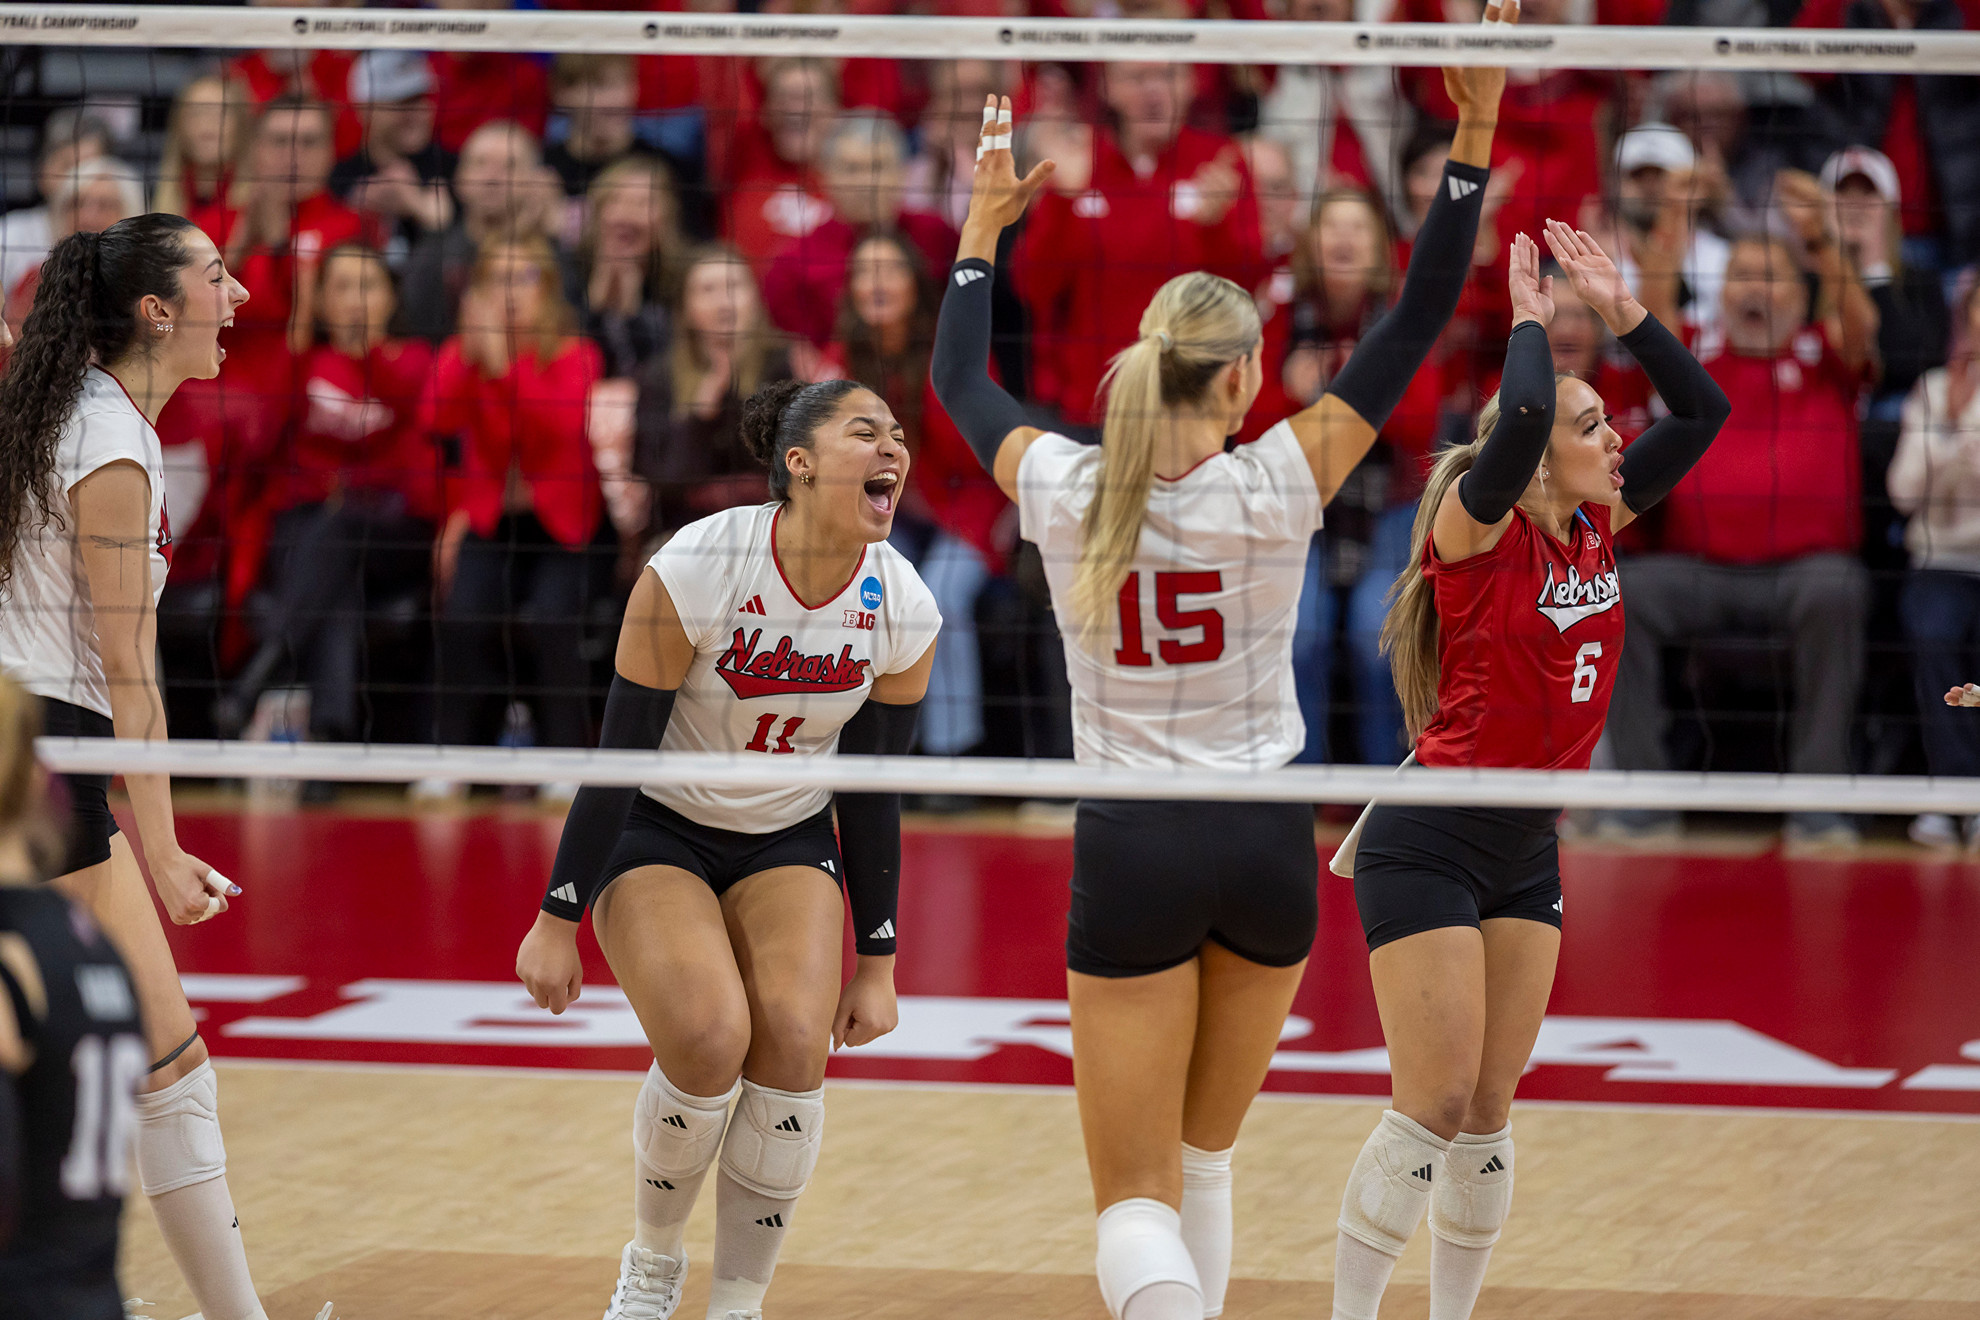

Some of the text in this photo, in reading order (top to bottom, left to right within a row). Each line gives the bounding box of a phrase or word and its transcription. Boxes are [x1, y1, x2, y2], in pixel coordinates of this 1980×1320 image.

[42, 17, 138, 31] CHAMPIONSHIP
[863, 590, 881, 602] NCAA
[1114, 570, 1225, 667] 15
[716, 627, 871, 685] Nebraska
[1571, 641, 1603, 704] 6
[744, 712, 806, 754] 11
